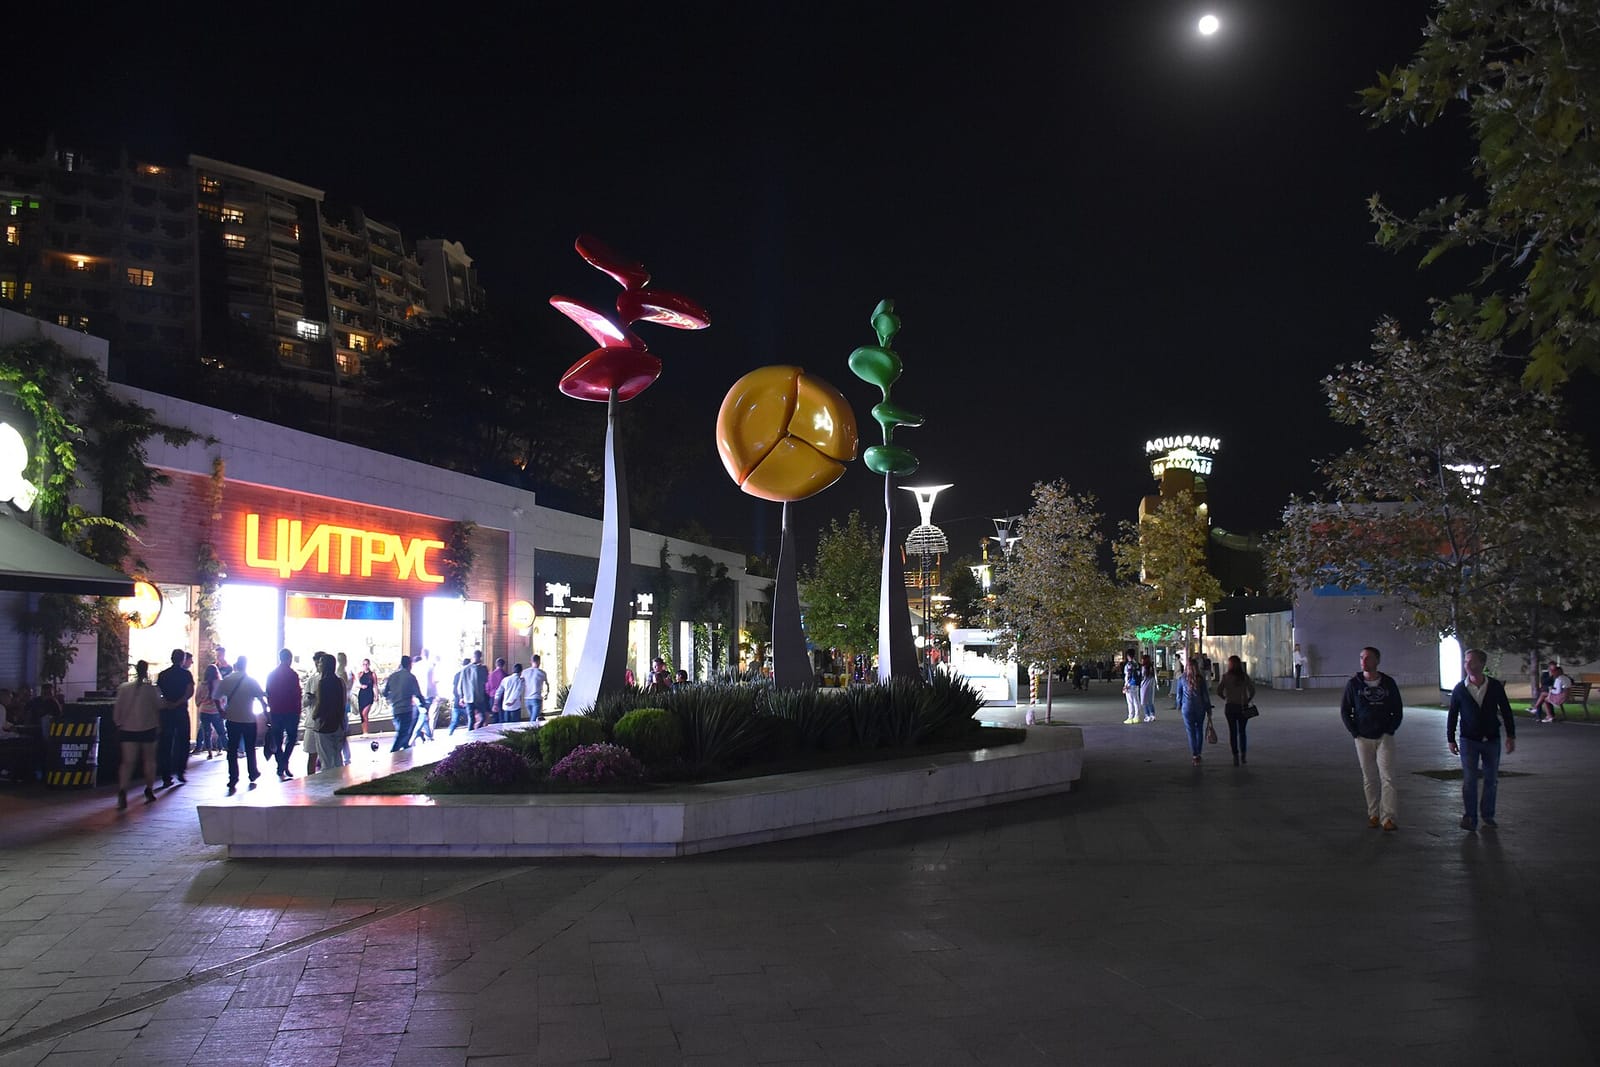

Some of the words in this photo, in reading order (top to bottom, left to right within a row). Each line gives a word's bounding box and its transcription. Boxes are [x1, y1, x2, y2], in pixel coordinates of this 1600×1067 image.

[1146, 435, 1220, 453] AQUAPARK
[1153, 459, 1212, 475] HAWAII
[246, 514, 445, 583] ЦИТРУС
